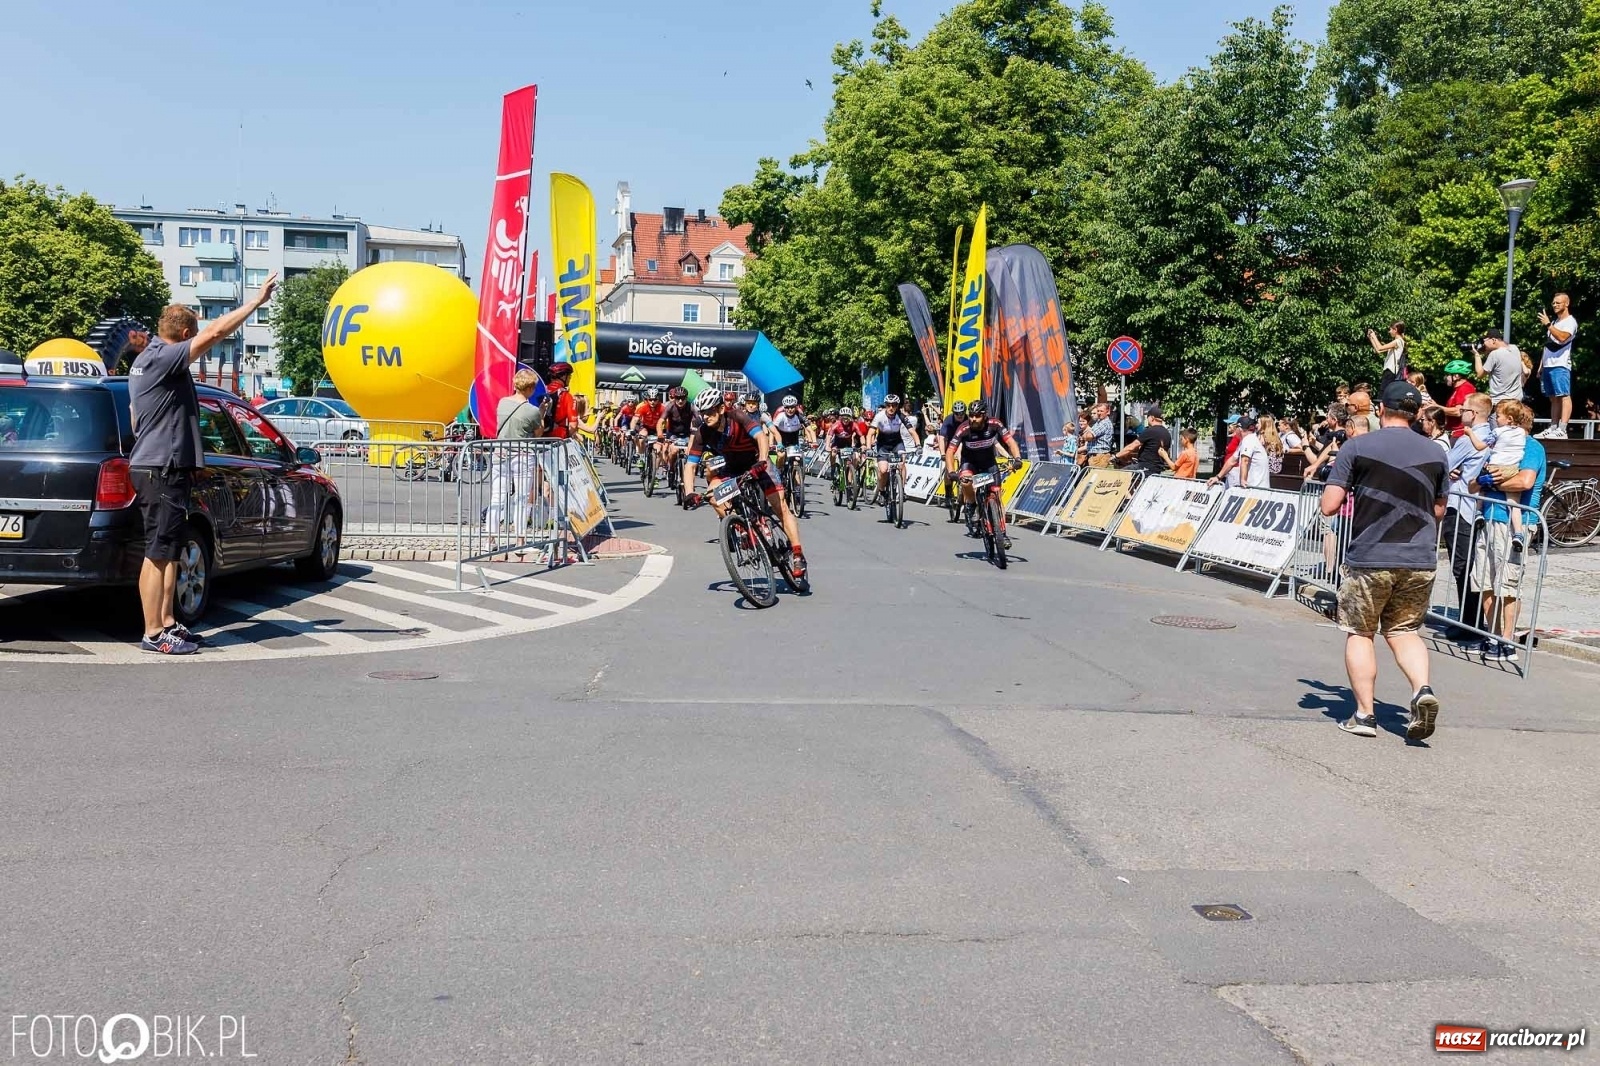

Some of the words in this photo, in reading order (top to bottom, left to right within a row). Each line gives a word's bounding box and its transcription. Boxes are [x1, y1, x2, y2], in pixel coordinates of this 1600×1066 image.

[361, 345, 402, 367] FM
[628, 337, 662, 355] bike
[666, 341, 717, 358] atelier
[718, 485, 733, 497] 1421
[1218, 495, 1284, 530] TAURUS
